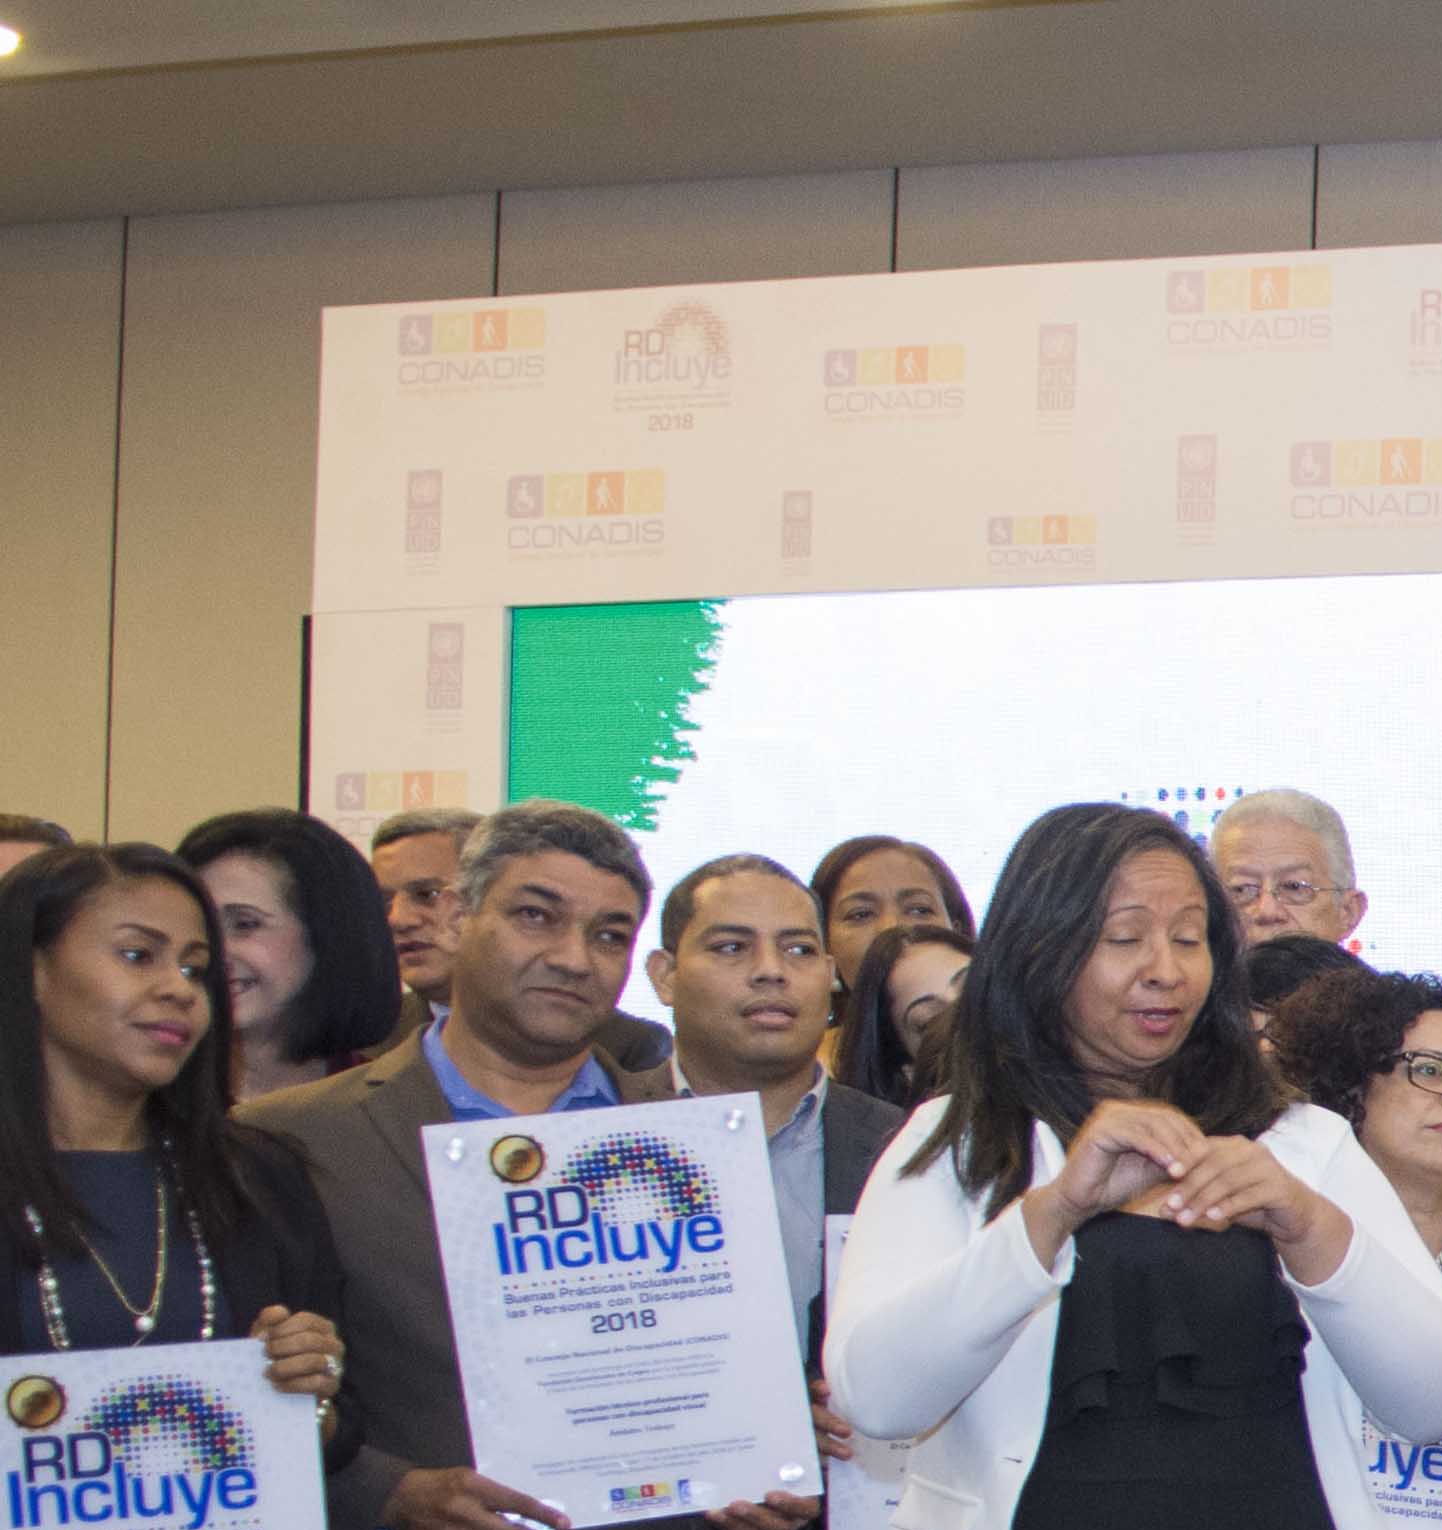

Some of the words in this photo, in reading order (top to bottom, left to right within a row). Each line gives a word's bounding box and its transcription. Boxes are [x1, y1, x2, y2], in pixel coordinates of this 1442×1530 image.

[1167, 314, 1332, 345] CONADIS
[823, 388, 966, 412] CONADIS
[507, 520, 665, 549] CONADIS
[505, 1185, 590, 1234] RD
[493, 1214, 725, 1277] Incluye
[503, 1292, 556, 1306] Buenas
[628, 1277, 696, 1291] Inclusivas
[699, 1272, 731, 1285] para
[505, 1309, 527, 1320] las
[532, 1303, 601, 1317] Personas
[607, 1298, 633, 1308] con
[638, 1284, 733, 1305] Discapacidad
[591, 1310, 657, 1335] 2018
[21, 1432, 112, 1484] RD
[7, 1464, 258, 1530] Incluye
